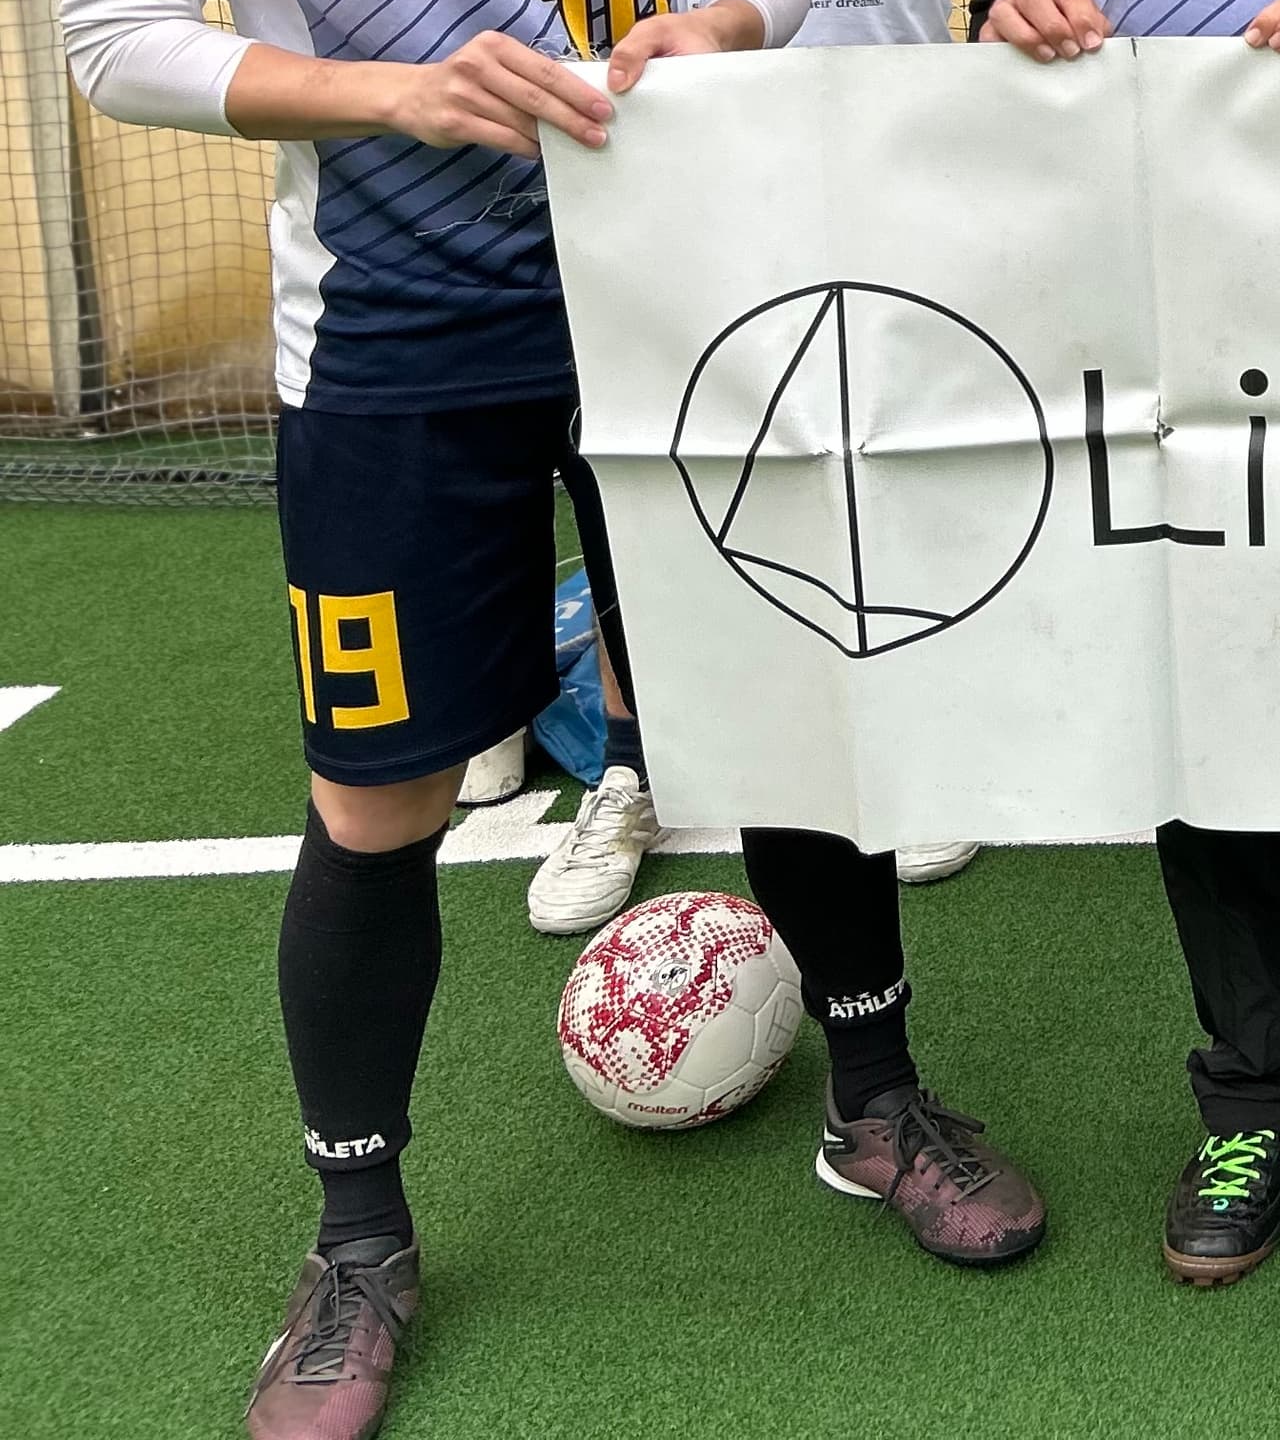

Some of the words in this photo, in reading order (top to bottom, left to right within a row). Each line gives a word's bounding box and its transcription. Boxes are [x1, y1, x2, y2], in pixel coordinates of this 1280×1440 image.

[288, 583, 410, 730] 19
[829, 978, 905, 1019] ATHLET
[627, 1101, 689, 1115] molten
